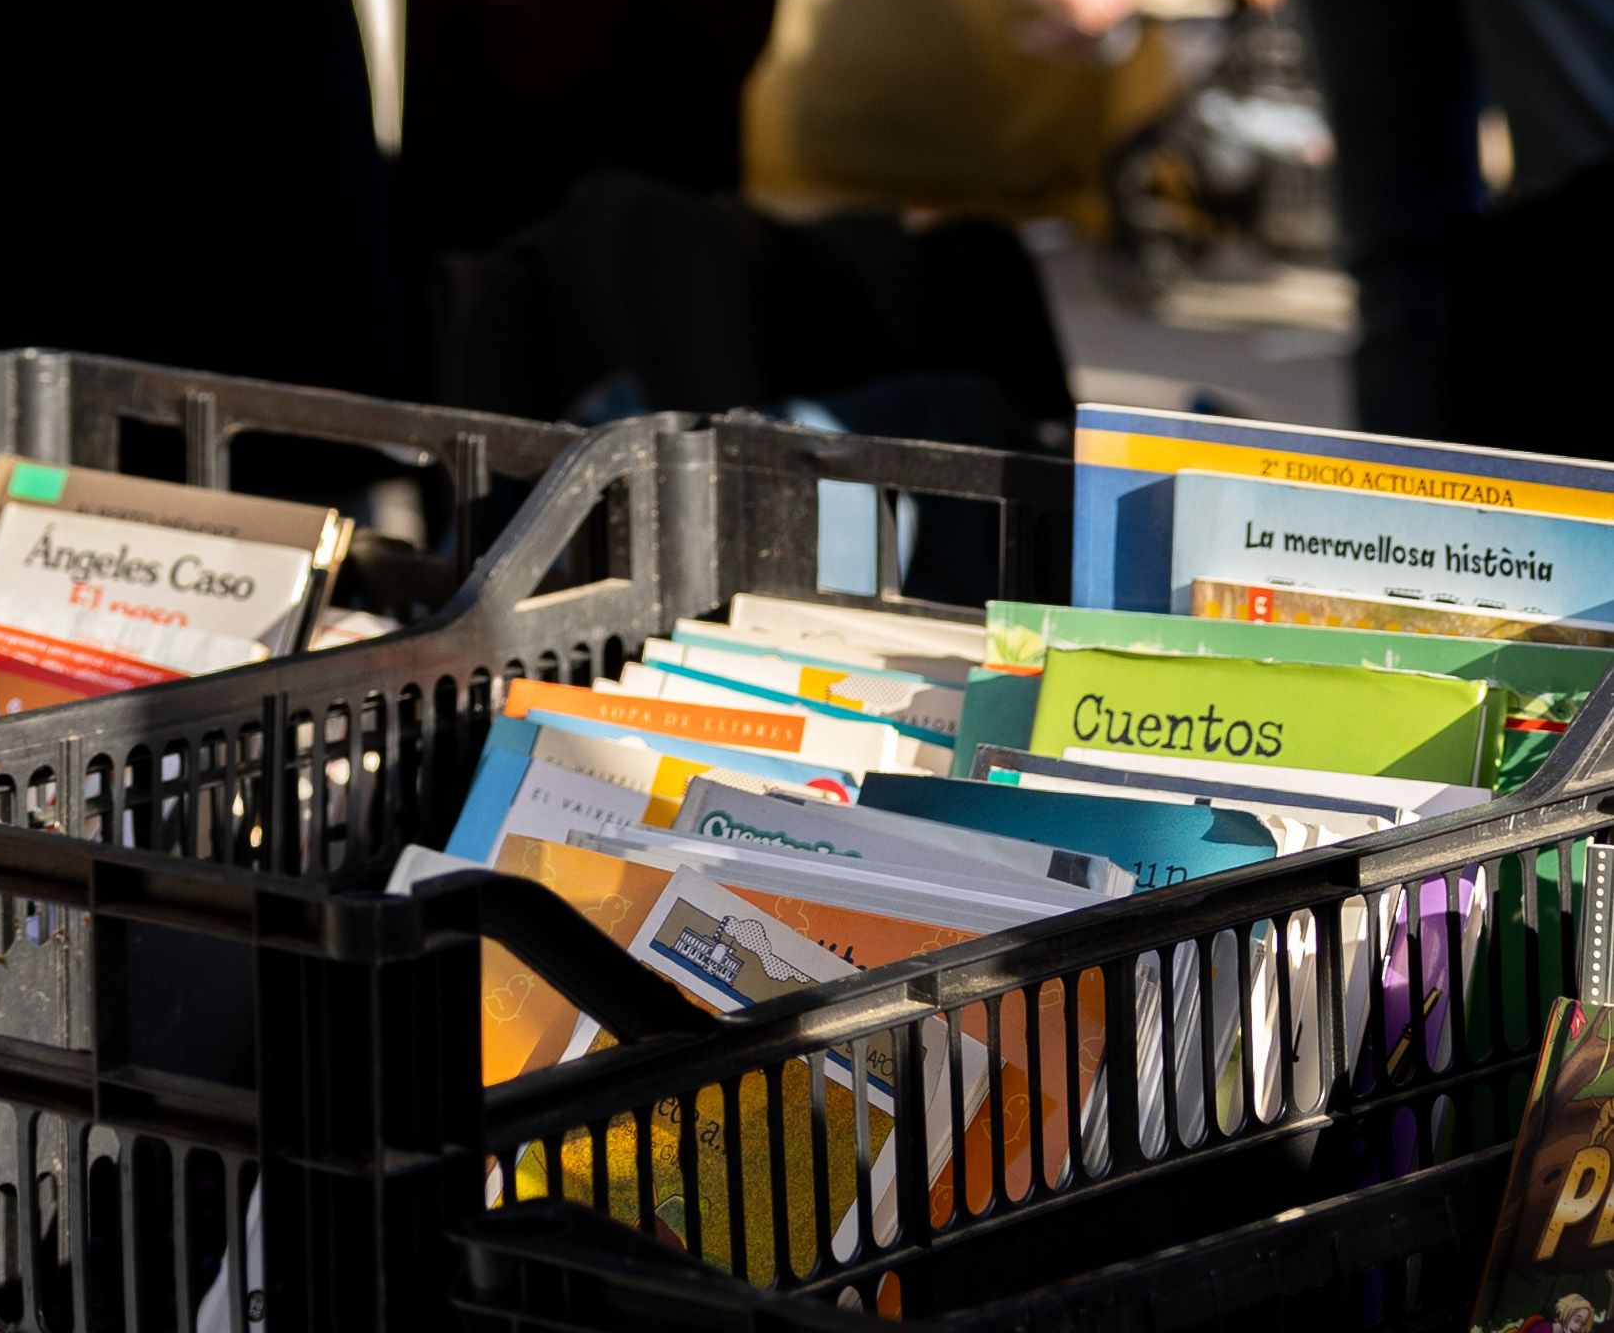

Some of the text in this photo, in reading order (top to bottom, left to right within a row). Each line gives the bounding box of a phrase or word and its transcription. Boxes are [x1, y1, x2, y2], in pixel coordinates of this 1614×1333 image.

[1285, 459, 1354, 486] EDICIÓ
[1361, 471, 1516, 508] ACTUALITZADA
[22, 521, 258, 602] Ángeles Caso
[1244, 520, 1555, 583] La meravellosa història
[599, 703, 795, 741] SOPA DE LLIBRES
[1072, 692, 1285, 758] Cuentos
